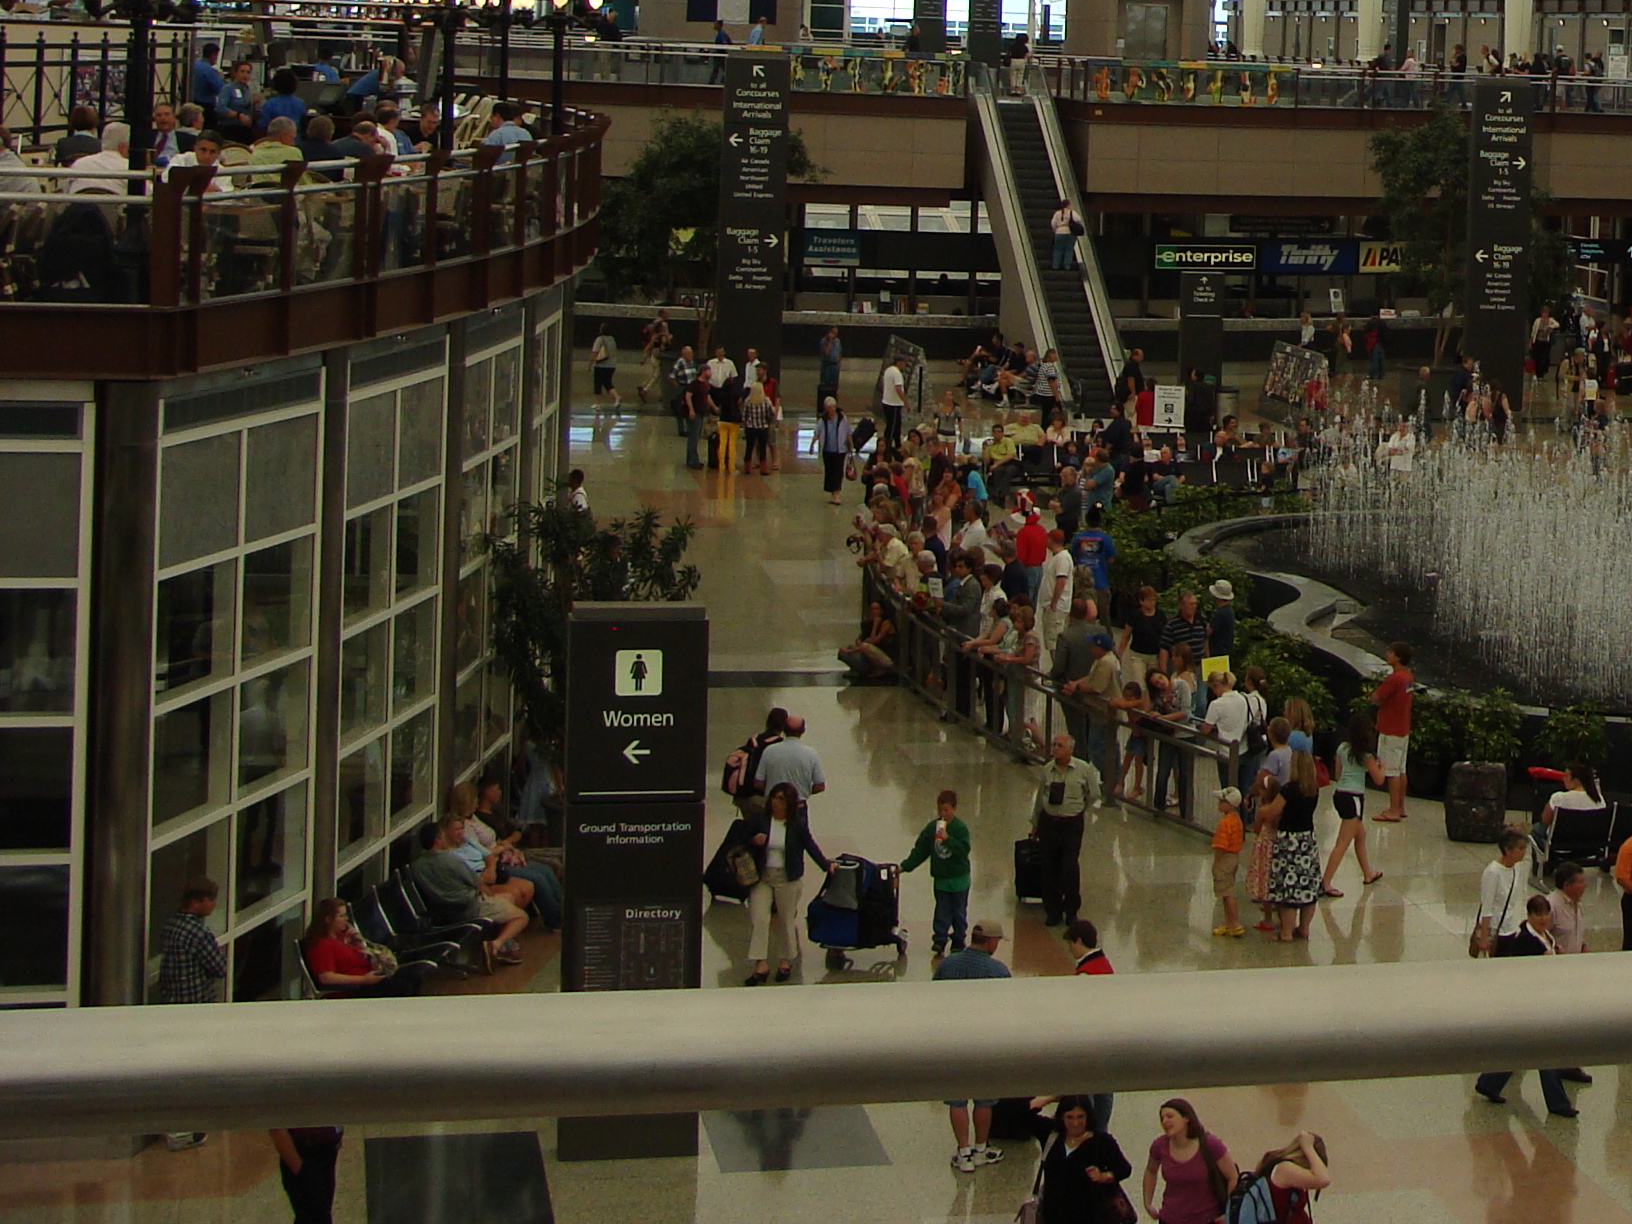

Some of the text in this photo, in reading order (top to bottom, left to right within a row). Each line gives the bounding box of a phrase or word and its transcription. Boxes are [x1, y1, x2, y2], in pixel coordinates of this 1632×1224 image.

[735, 88, 780, 98] Concourses
[732, 101, 782, 110] International
[742, 110, 772, 119] Arrivals
[1485, 113, 1524, 122] Concourses
[749, 128, 783, 138] Baggage
[1482, 125, 1527, 134] International
[749, 137, 771, 145] Claim
[1491, 134, 1518, 143] Arrivals
[1480, 150, 1510, 160] Baggage
[1490, 159, 1509, 167] Claim
[726, 227, 760, 238] Baggage
[738, 237, 760, 245] Claim
[813, 236, 855, 245] Travelers
[808, 244, 857, 253] Assistance
[1493, 244, 1523, 254] Baggage
[1161, 249, 1253, 266] enterprise
[1280, 244, 1340, 270] Thrifty
[1493, 253, 1513, 261] Claim
[602, 710, 674, 728] Women
[579, 822, 692, 835] Ground Transportation
[606, 834, 664, 845] Information
[625, 908, 682, 920] Directory
